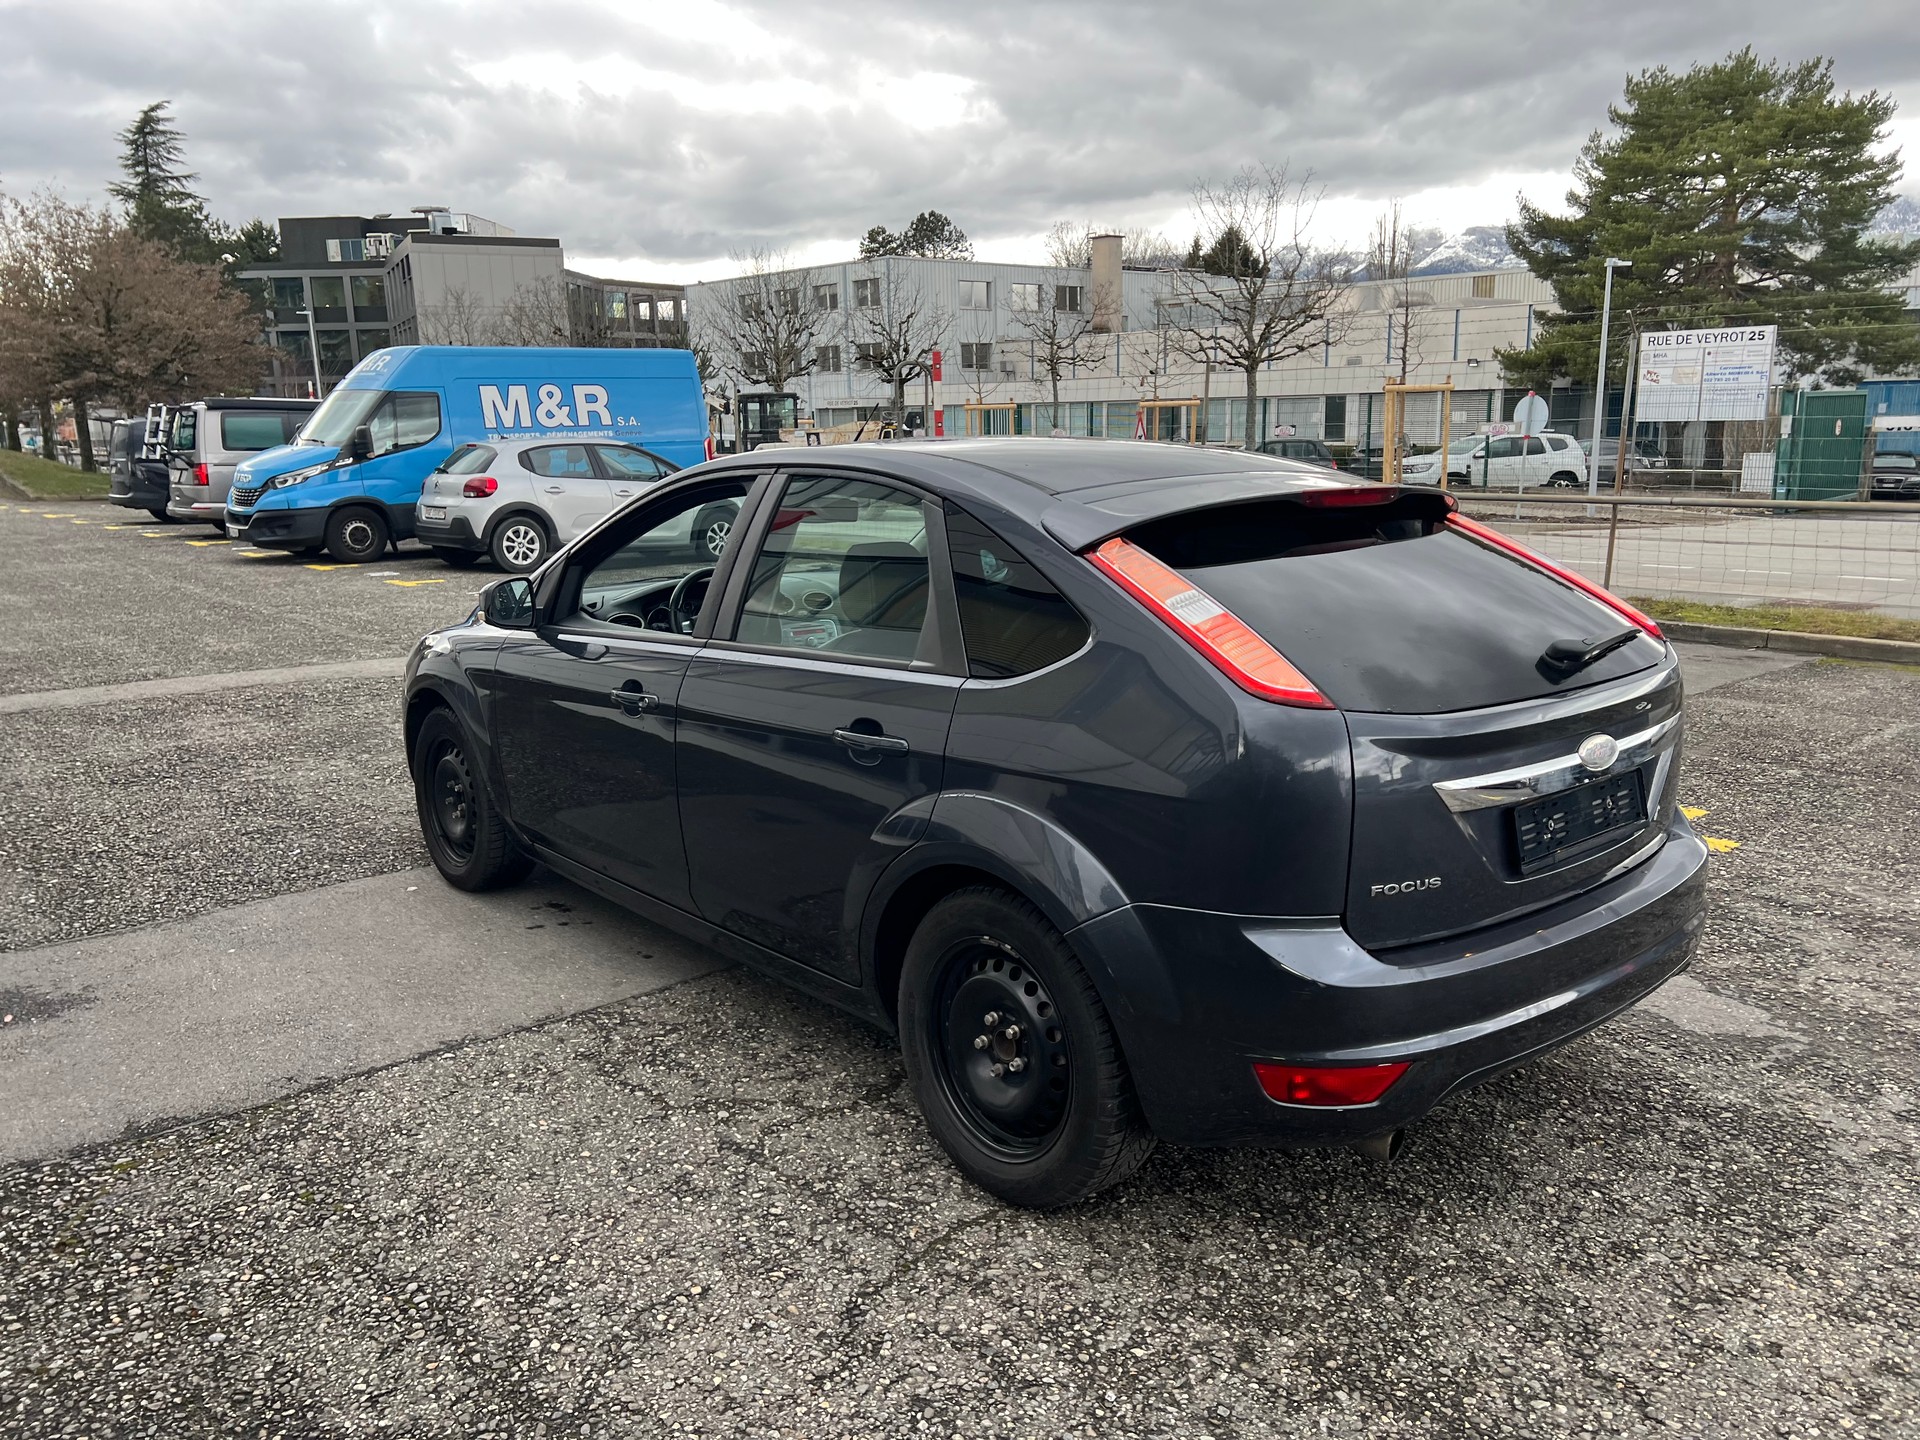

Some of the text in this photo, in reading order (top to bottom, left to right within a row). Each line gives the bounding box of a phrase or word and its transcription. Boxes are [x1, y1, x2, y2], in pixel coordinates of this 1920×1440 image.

[1648, 330, 1765, 346] RUE DE VEYROT 25
[478, 382, 641, 429] M&R S.A.
[1371, 877, 1442, 897] FOCUS
